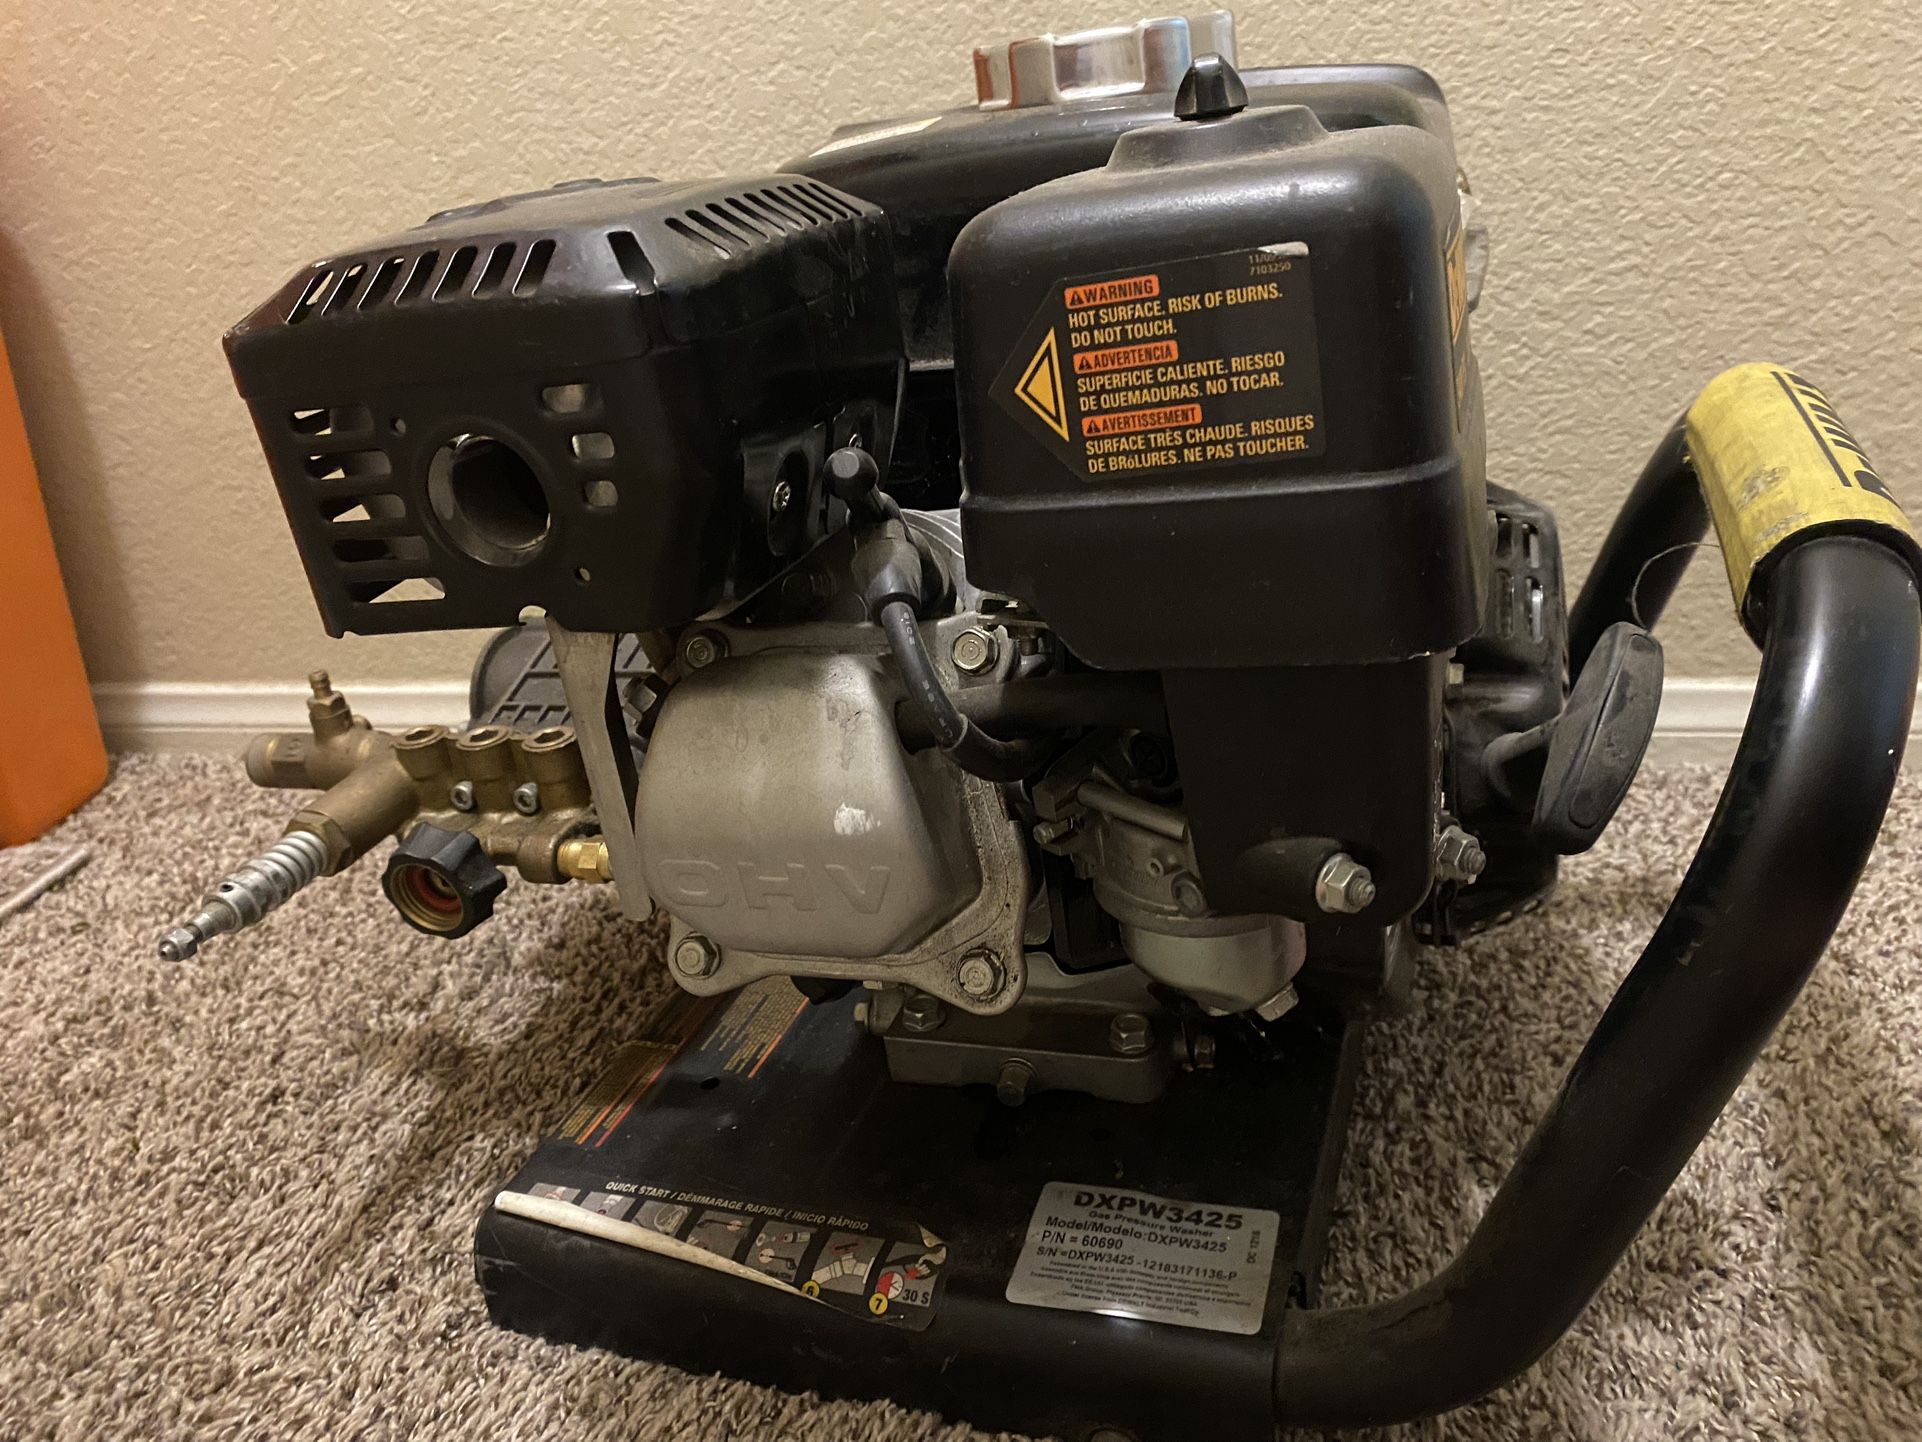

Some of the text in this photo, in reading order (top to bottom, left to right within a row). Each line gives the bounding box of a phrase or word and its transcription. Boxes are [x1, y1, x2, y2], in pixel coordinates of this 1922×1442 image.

[1084, 280, 1154, 301] WARNING
[1068, 282, 1283, 329] HOT SURFACE. RISK OF BURNS.
[1071, 319, 1177, 348] DO NOT TOUCH.
[1094, 345, 1173, 369] ADVERTENCIA
[1077, 351, 1286, 393] SUPERFICIE CALIENTE. RIESGO
[1080, 371, 1284, 412] DE QUEMADURAS. NO TOCAR.
[1085, 414, 1314, 455] SURFACE TRÈS CHAUDE. RISQUES
[1102, 407, 1197, 433] AVERTISSEMENT
[1088, 457, 1106, 474] DE
[1184, 446, 1203, 463] NE
[1206, 443, 1234, 460] PAS
[1237, 435, 1309, 458] TOUCHER.
[657, 859, 890, 914] OHV
[605, 1181, 638, 1194] QUICK
[638, 1185, 671, 1199] START
[744, 1203, 784, 1218] RAPIDE
[792, 1211, 825, 1225] INICIO
[1073, 1190, 1243, 1231] DXPW3425
[1089, 1210, 1215, 1239] Gas Pressure Washer
[1036, 1246, 1058, 1258] S/N
[1041, 1230, 1066, 1245] P/N
[1081, 1234, 1123, 1250] 60690
[875, 1299, 883, 1311] 7
[902, 1289, 930, 1305] 30 S
